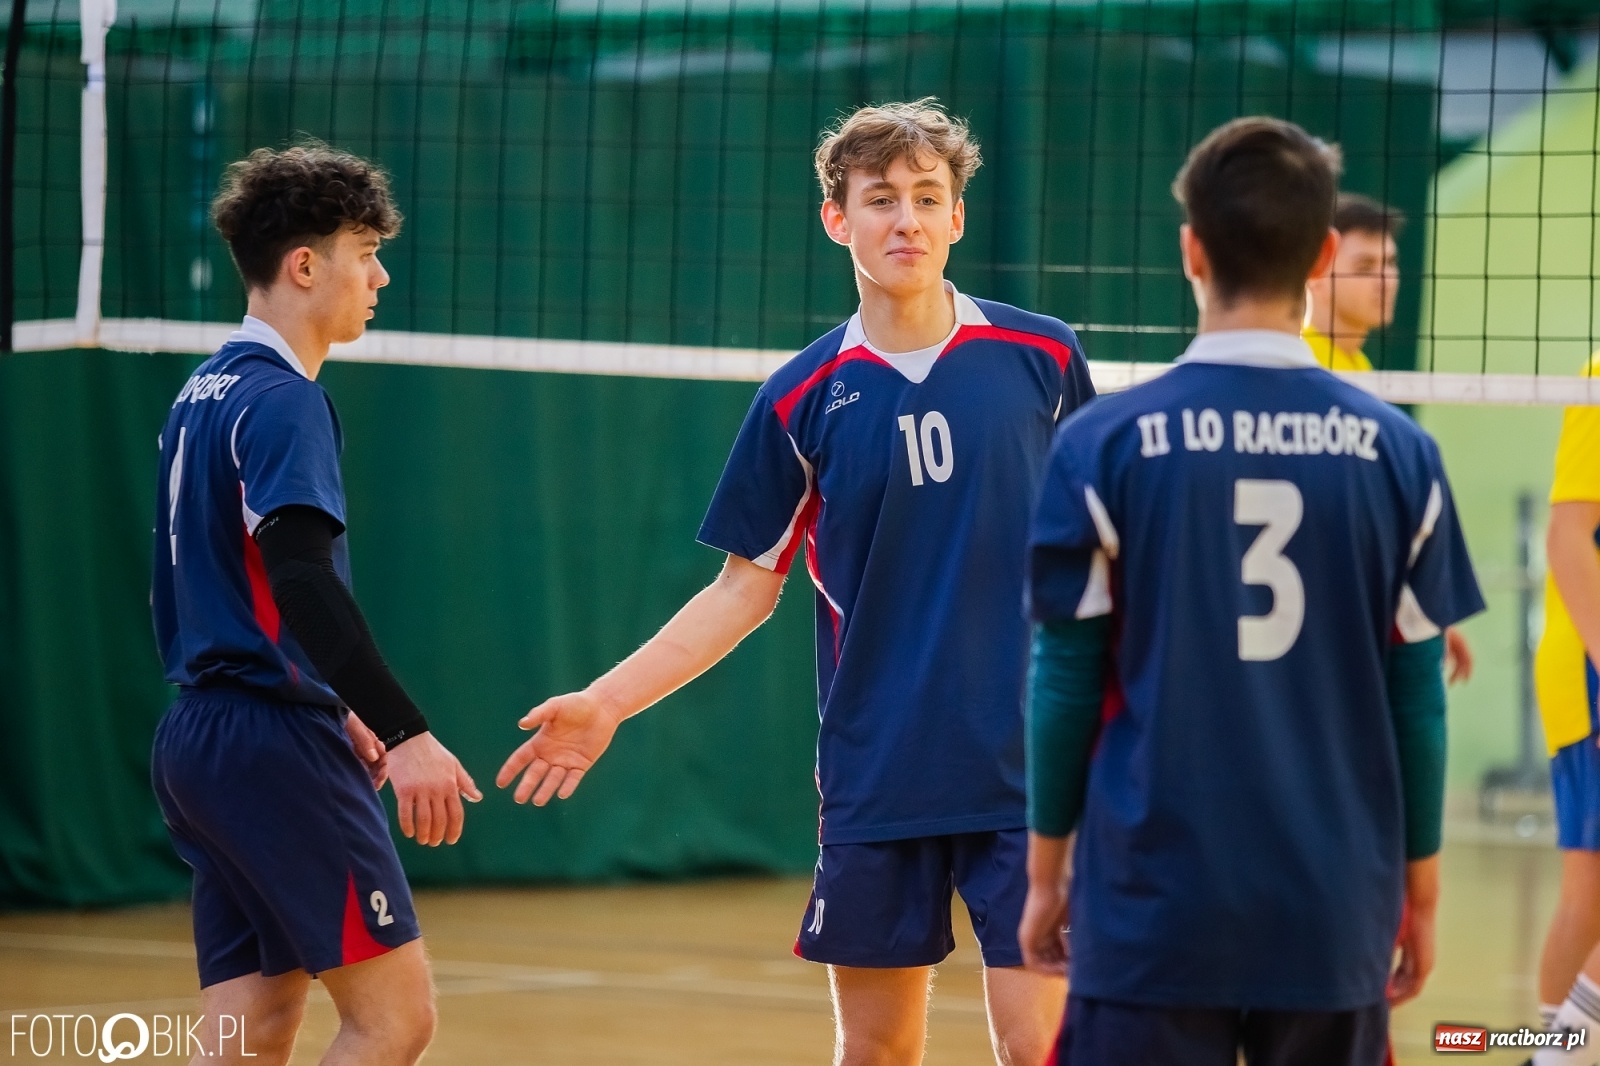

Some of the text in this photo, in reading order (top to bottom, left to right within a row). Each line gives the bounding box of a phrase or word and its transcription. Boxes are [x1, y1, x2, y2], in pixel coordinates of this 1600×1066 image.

[898, 411, 954, 486] 10
[1137, 406, 1379, 461] II LO RACIBÓRZ
[1234, 479, 1305, 661] 3
[370, 890, 394, 926] 2
